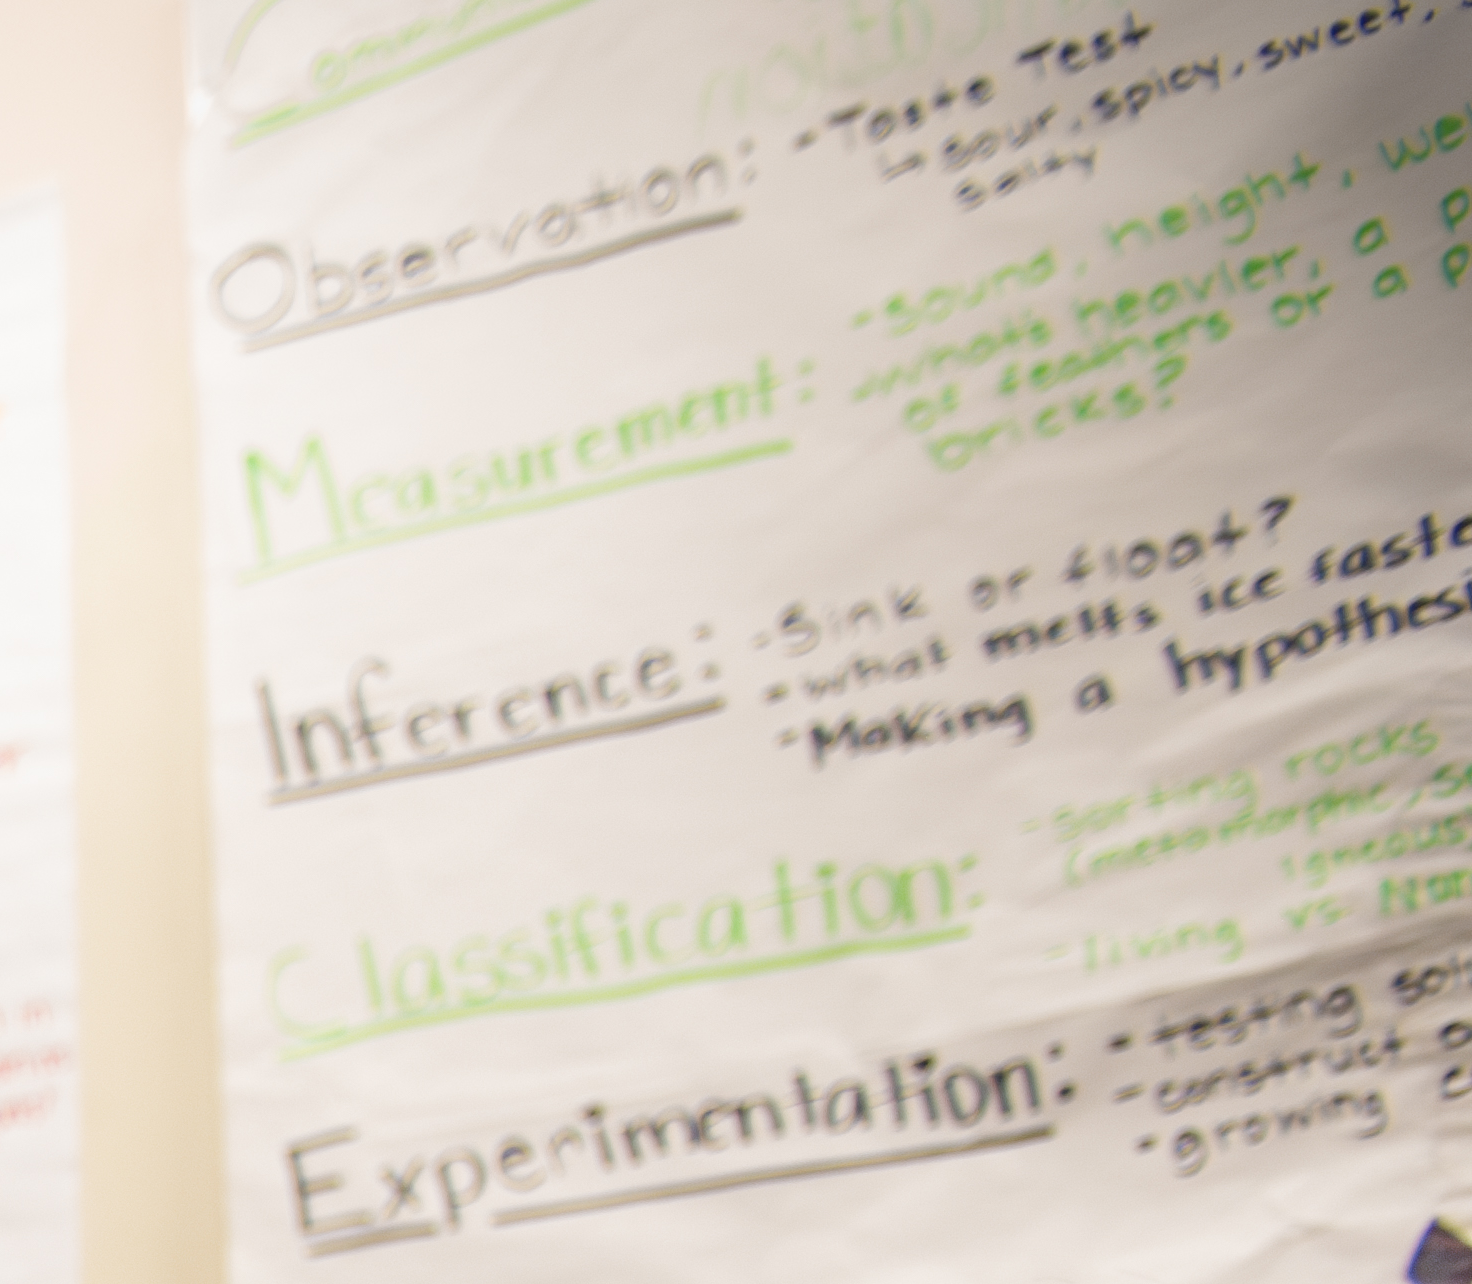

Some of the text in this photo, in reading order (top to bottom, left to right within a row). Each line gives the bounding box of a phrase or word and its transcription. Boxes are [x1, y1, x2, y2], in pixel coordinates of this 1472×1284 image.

[209, 135, 759, 337] Observation:
[240, 355, 819, 570] Measurement:
[970, 566, 1032, 610] or
[982, 597, 1164, 660] melts
[1197, 562, 1287, 618] ice
[255, 622, 720, 782] Inference:
[1074, 673, 1116, 714] a
[265, 853, 984, 1042] Classification:
[1149, 982, 1364, 1059] testing
[284, 1040, 1079, 1232] Experimentation:
[1173, 1090, 1388, 1178] growing
